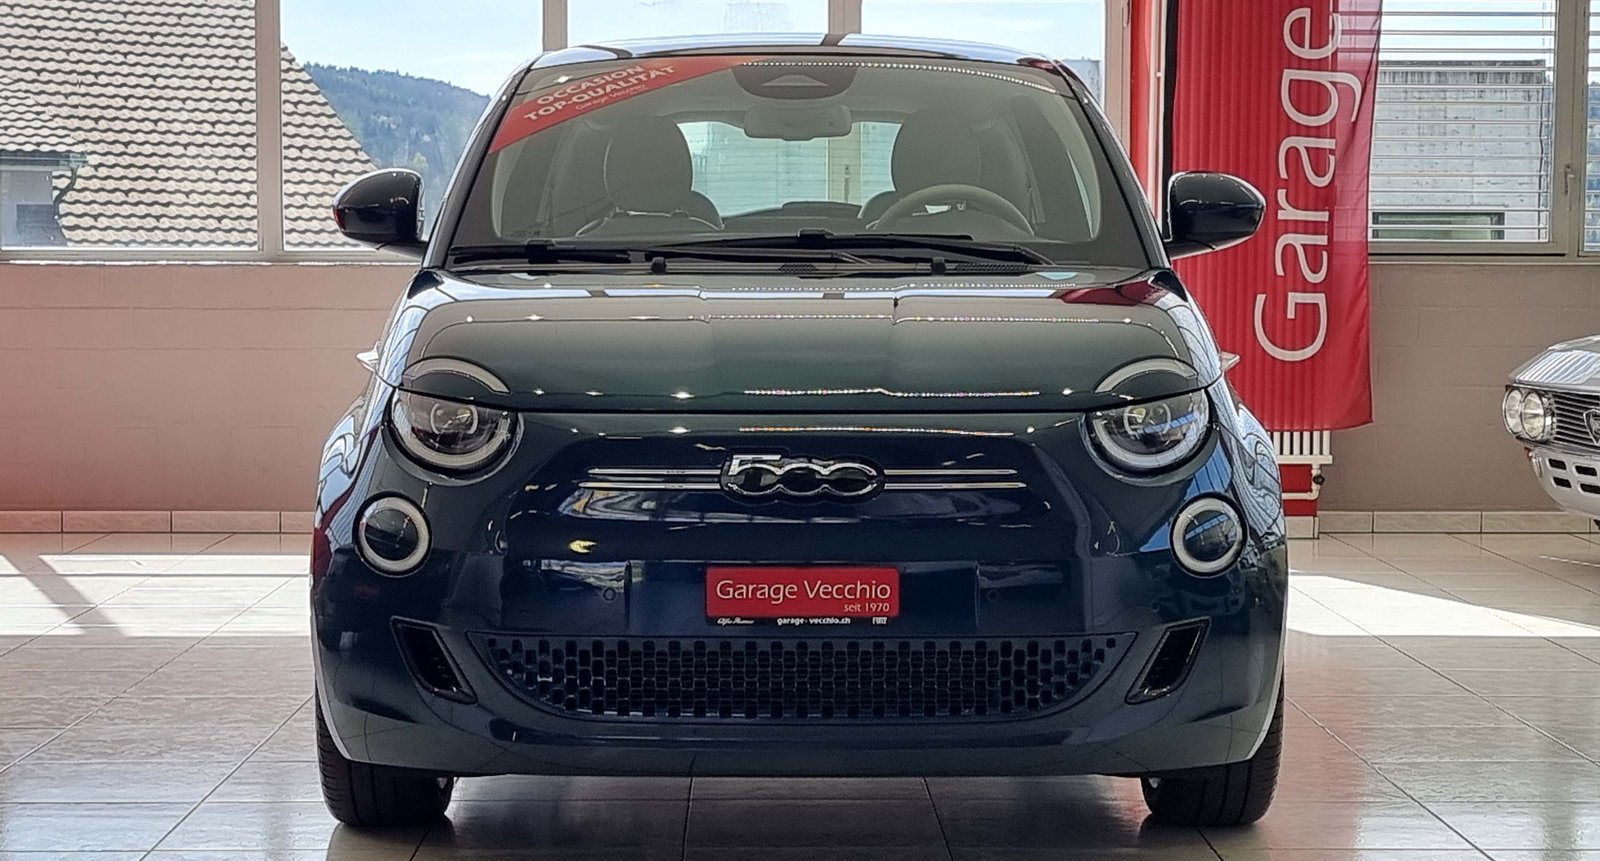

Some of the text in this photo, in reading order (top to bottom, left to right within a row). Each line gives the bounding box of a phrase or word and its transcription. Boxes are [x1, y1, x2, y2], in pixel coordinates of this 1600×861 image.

[524, 65, 676, 121] TOP-QUALITÄT
[537, 65, 645, 105] OCCASION
[1253, 7, 1363, 362] Garage
[726, 454, 878, 496] 500
[716, 580, 891, 605] Garage Vecchio
[843, 603, 890, 613] seit 1970
